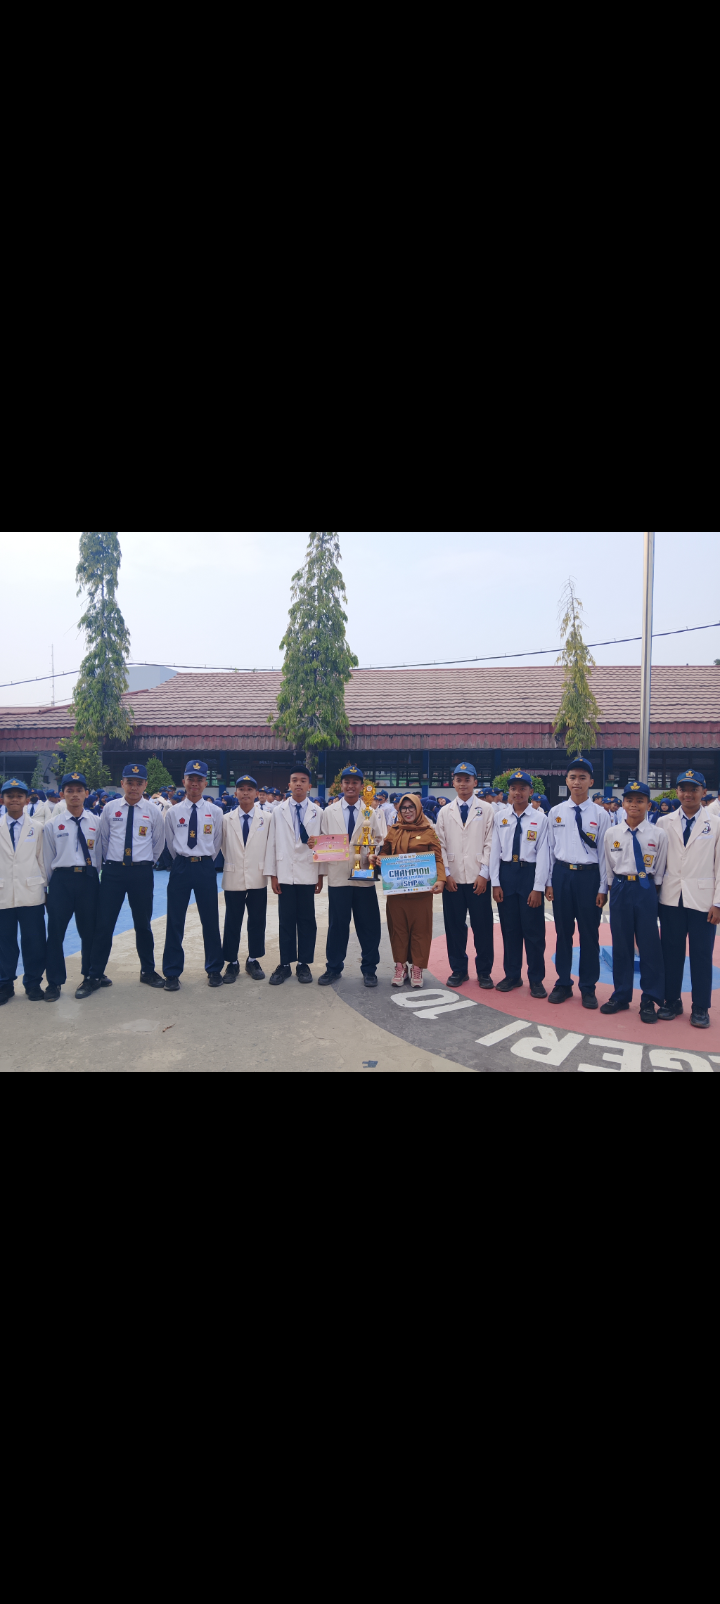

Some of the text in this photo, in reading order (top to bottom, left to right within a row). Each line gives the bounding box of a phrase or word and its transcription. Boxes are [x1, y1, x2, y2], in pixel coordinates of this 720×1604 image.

[389, 867, 430, 877] CHAMPION
[390, 988, 720, 1072] GERI 10
